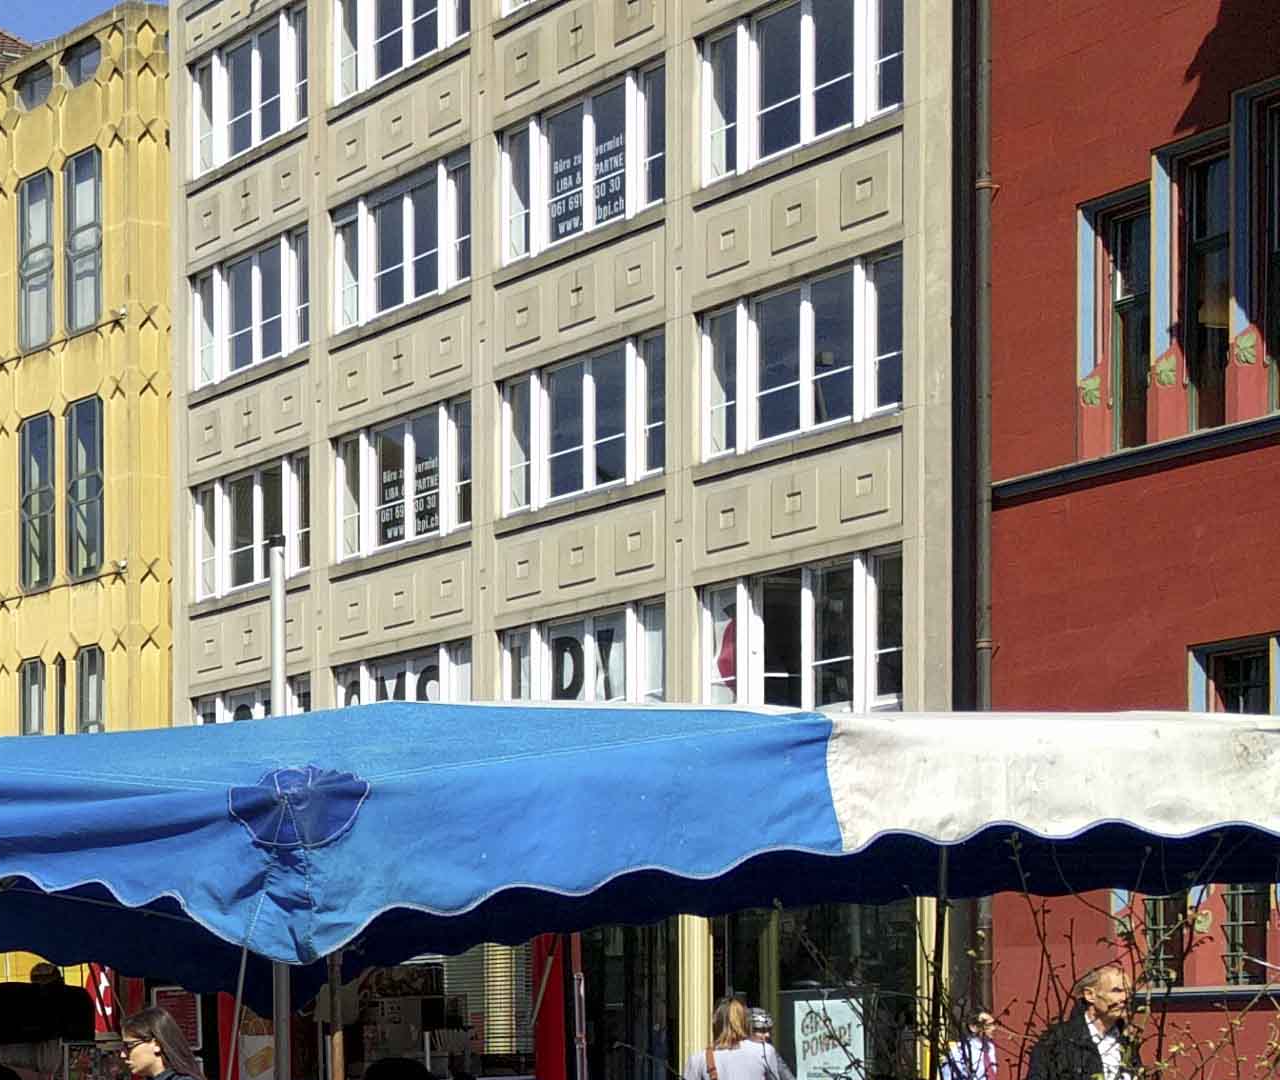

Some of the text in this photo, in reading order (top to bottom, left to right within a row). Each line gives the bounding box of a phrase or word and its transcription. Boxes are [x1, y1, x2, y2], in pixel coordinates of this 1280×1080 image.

[551, 199, 566, 218] 061
[609, 176, 621, 194] 30
[556, 175, 573, 193] LIBA
